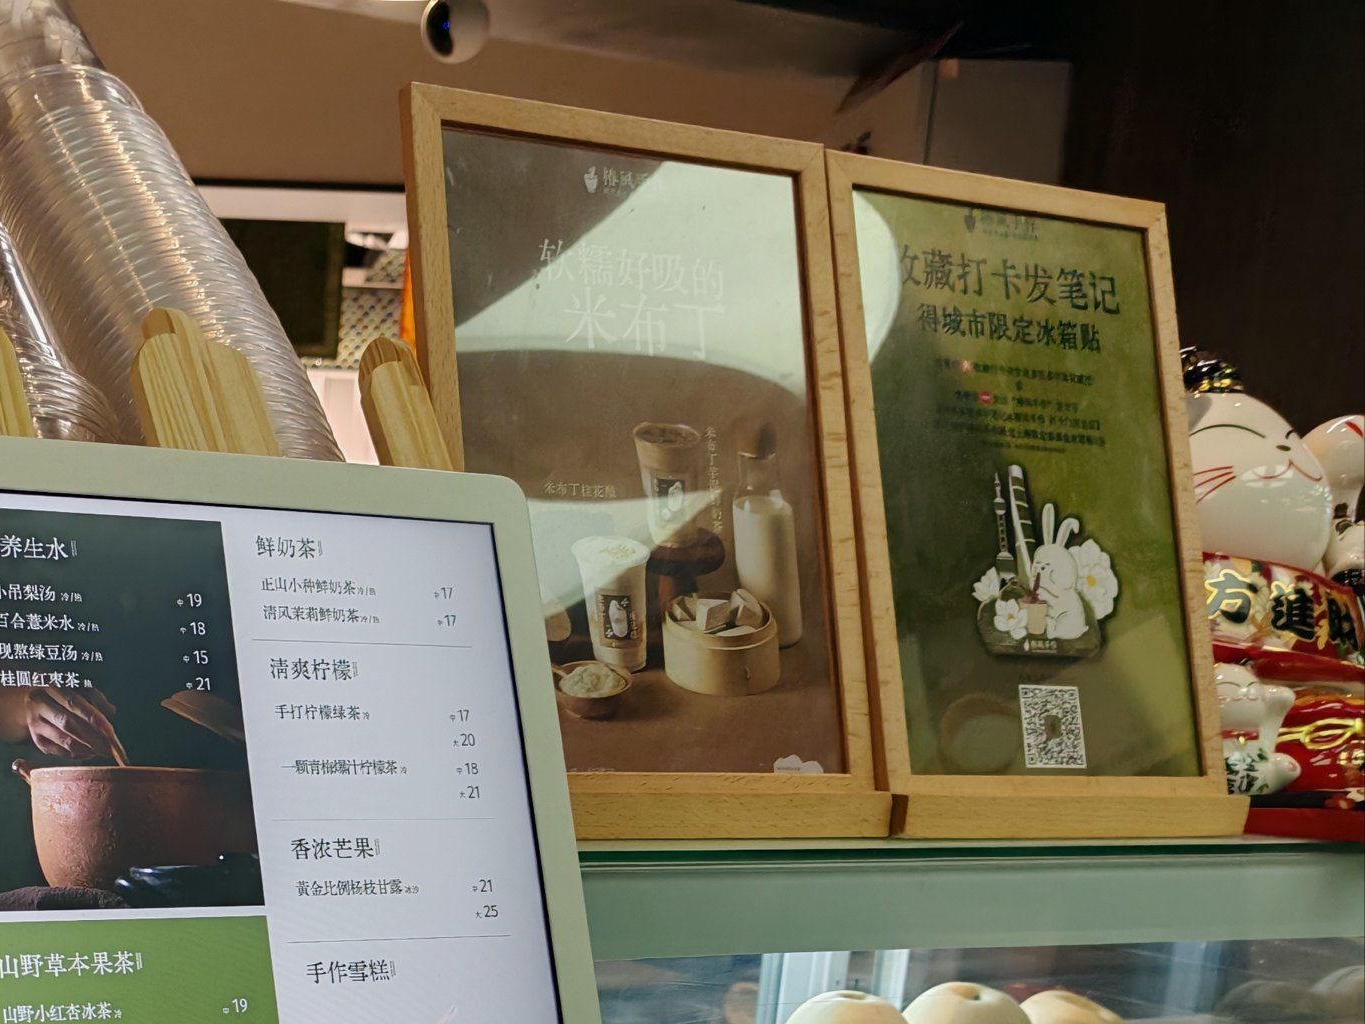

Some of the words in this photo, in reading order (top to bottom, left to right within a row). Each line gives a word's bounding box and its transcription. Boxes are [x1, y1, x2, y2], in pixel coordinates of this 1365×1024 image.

[564, 286, 726, 359] 米布丁
[256, 535, 316, 559] 鲜奶茶
[270, 658, 352, 681] 清爽柠檬
[275, 705, 361, 720] 手打柠檬绿茶
[291, 838, 375, 860] 香浓芒果
[306, 960, 390, 984] 手作雪糕
[3, 1001, 112, 1024] 山野小红杏冰茶
